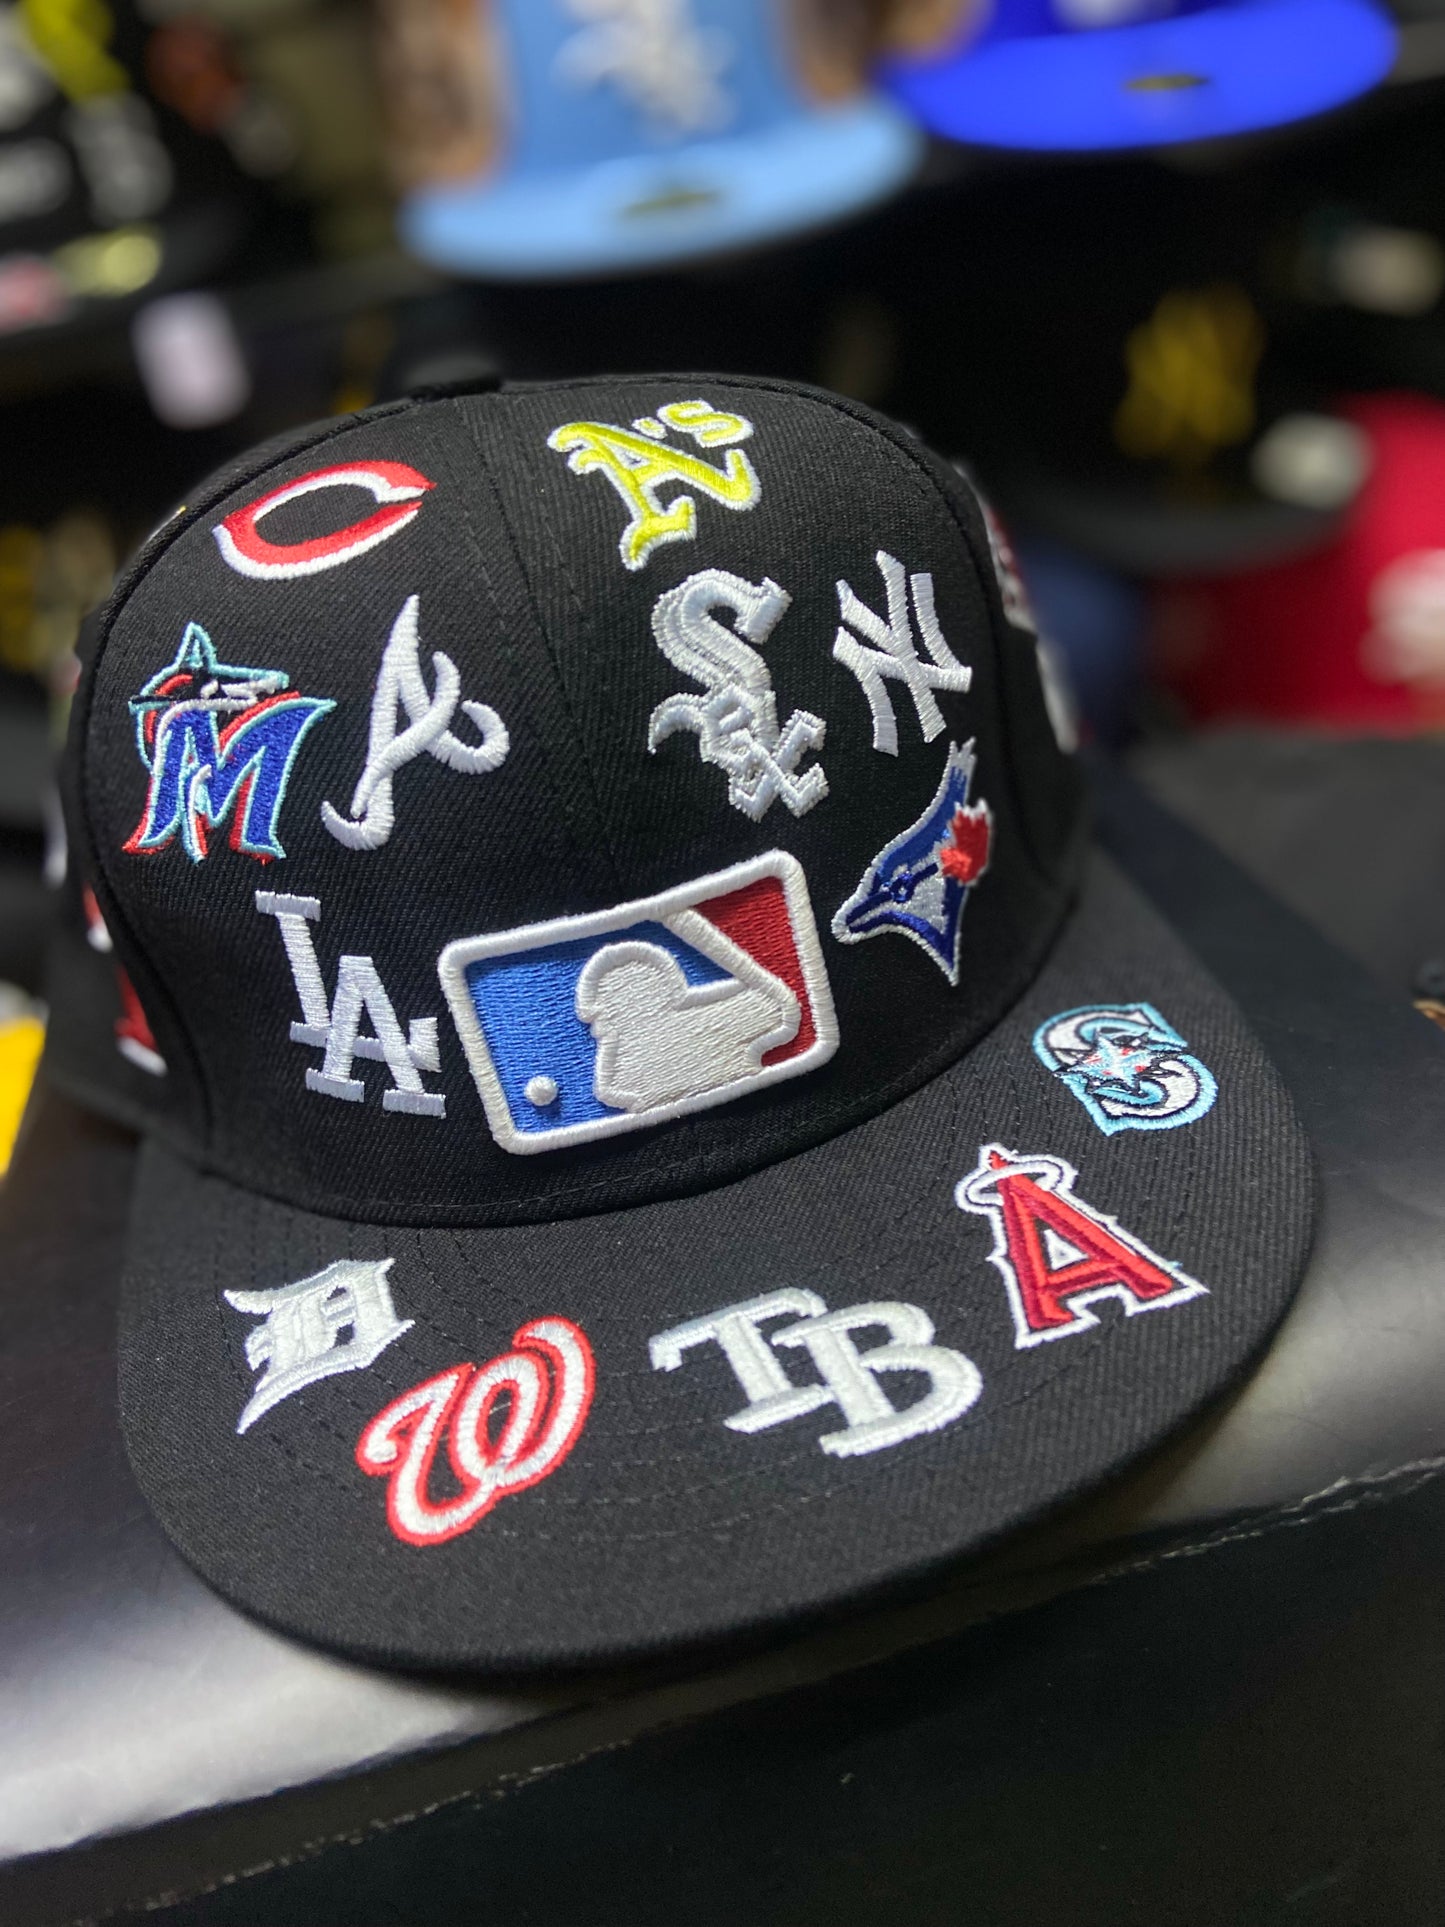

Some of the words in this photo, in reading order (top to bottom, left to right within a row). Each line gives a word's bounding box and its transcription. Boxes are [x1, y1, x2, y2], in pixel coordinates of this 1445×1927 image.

[212, 459, 436, 580] C
[547, 399, 762, 571] A's
[832, 550, 973, 757] NY
[122, 690, 337, 865] M
[255, 889, 447, 1118] LA
[954, 1142, 1211, 1349] A
[223, 1257, 416, 1435] D
[355, 1315, 596, 1546] W
[648, 1286, 983, 1459] TB
